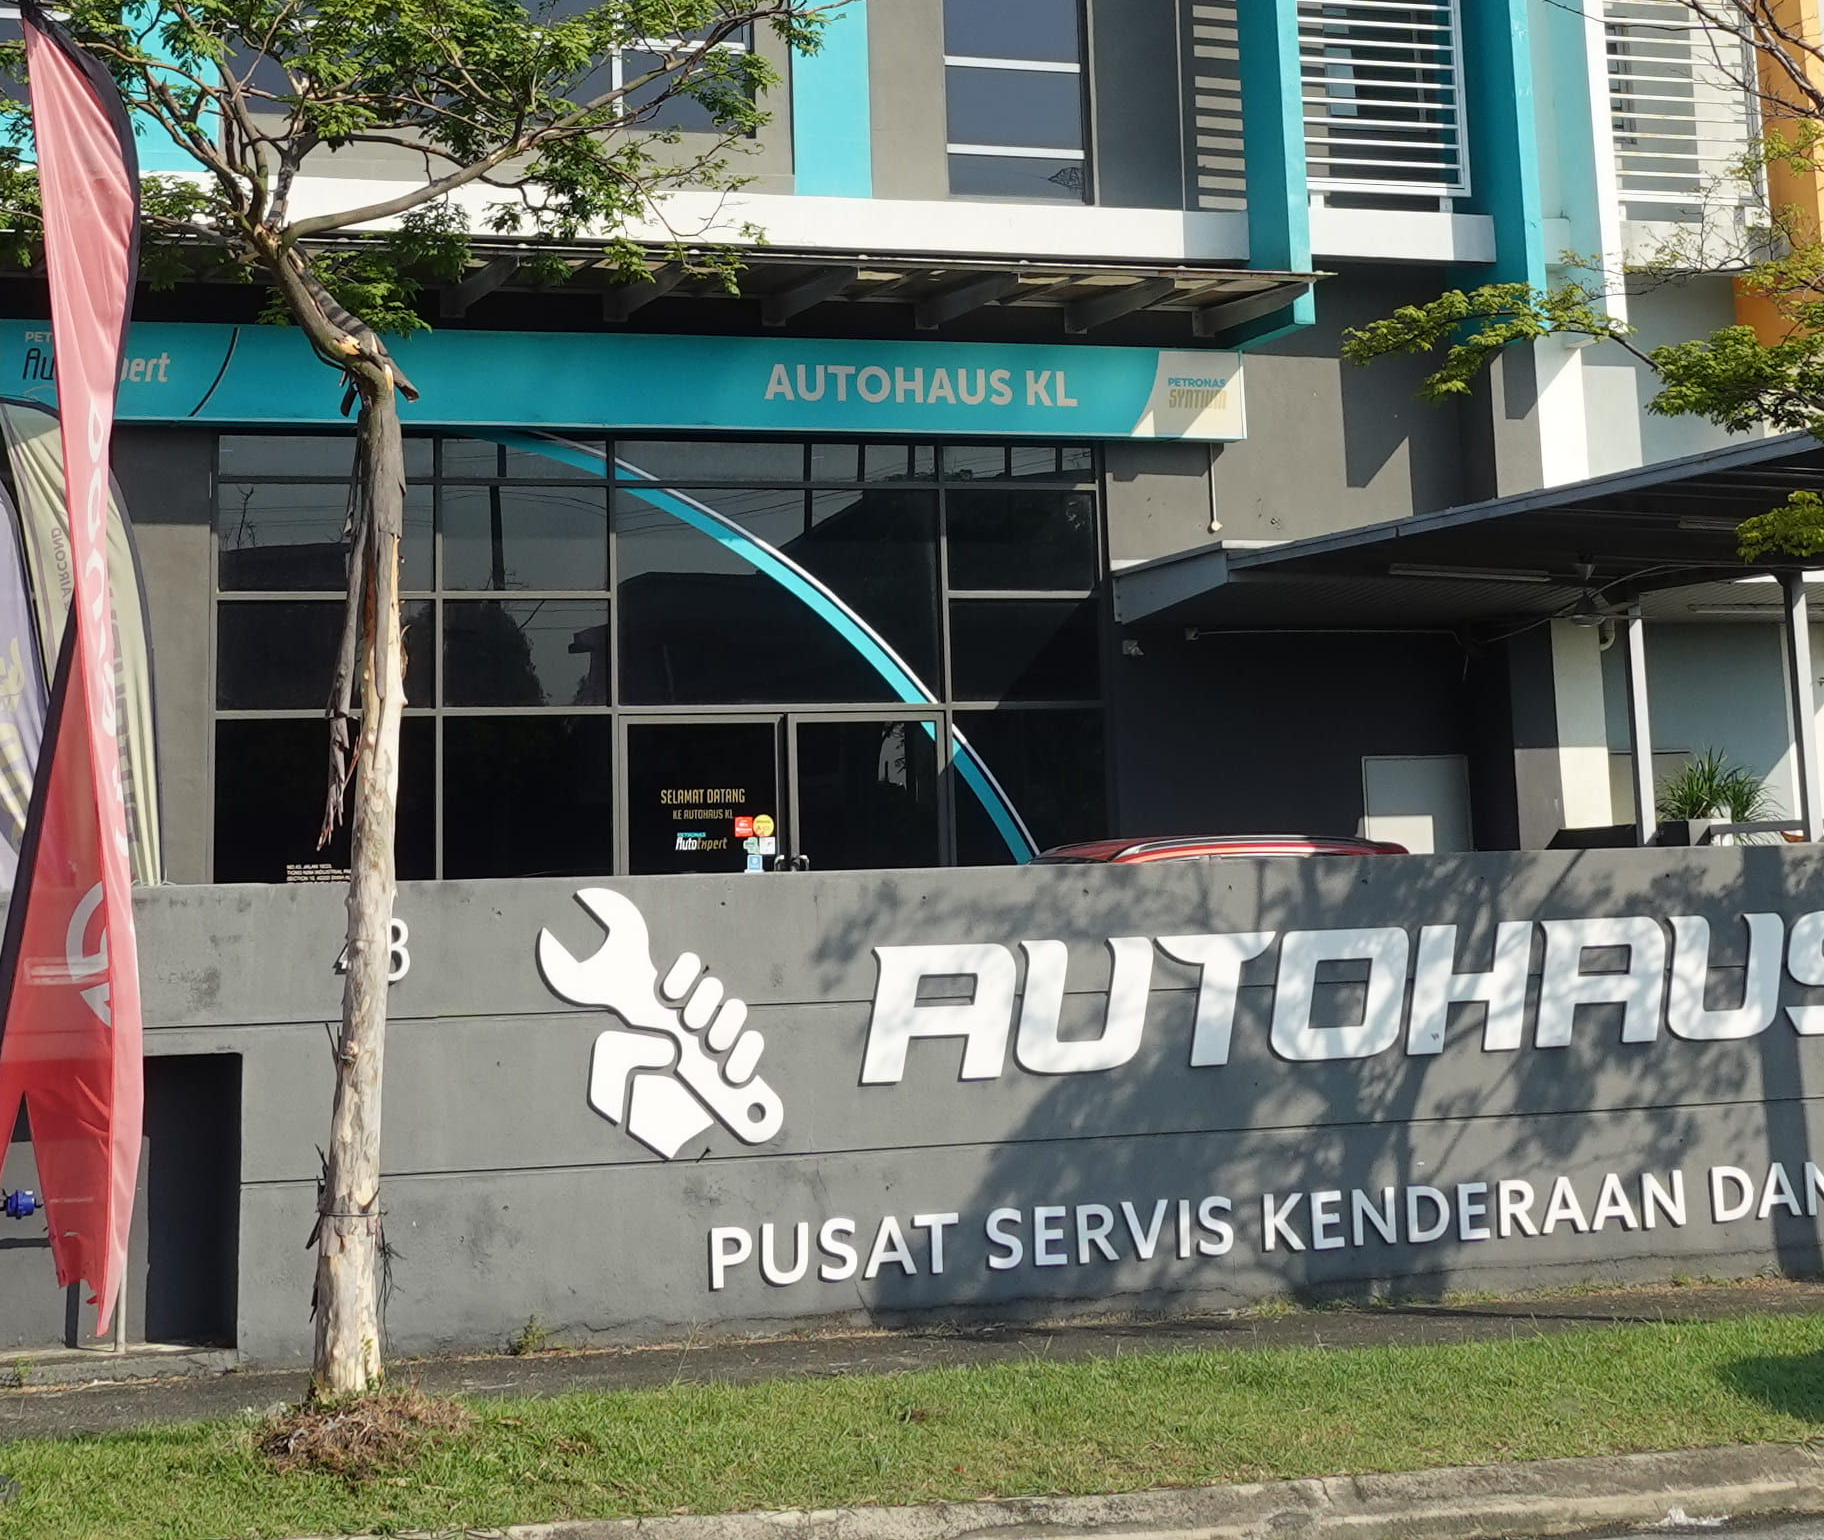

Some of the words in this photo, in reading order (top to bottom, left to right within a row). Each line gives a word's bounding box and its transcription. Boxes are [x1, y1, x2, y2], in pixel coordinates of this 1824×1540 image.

[764, 363, 1014, 406] AUTOHAUS
[1026, 369, 1078, 409] KL
[1167, 377, 1226, 388] PETRONAS
[660, 788, 704, 805] SELAMAT
[706, 788, 746, 804] DATANG
[672, 809, 682, 820] KE
[683, 808, 724, 820] AUTOHAUS
[708, 1212, 959, 1292] PUSAT
[984, 1195, 1234, 1271] SERVIS
[1261, 1168, 1687, 1253] KENDERAAN
